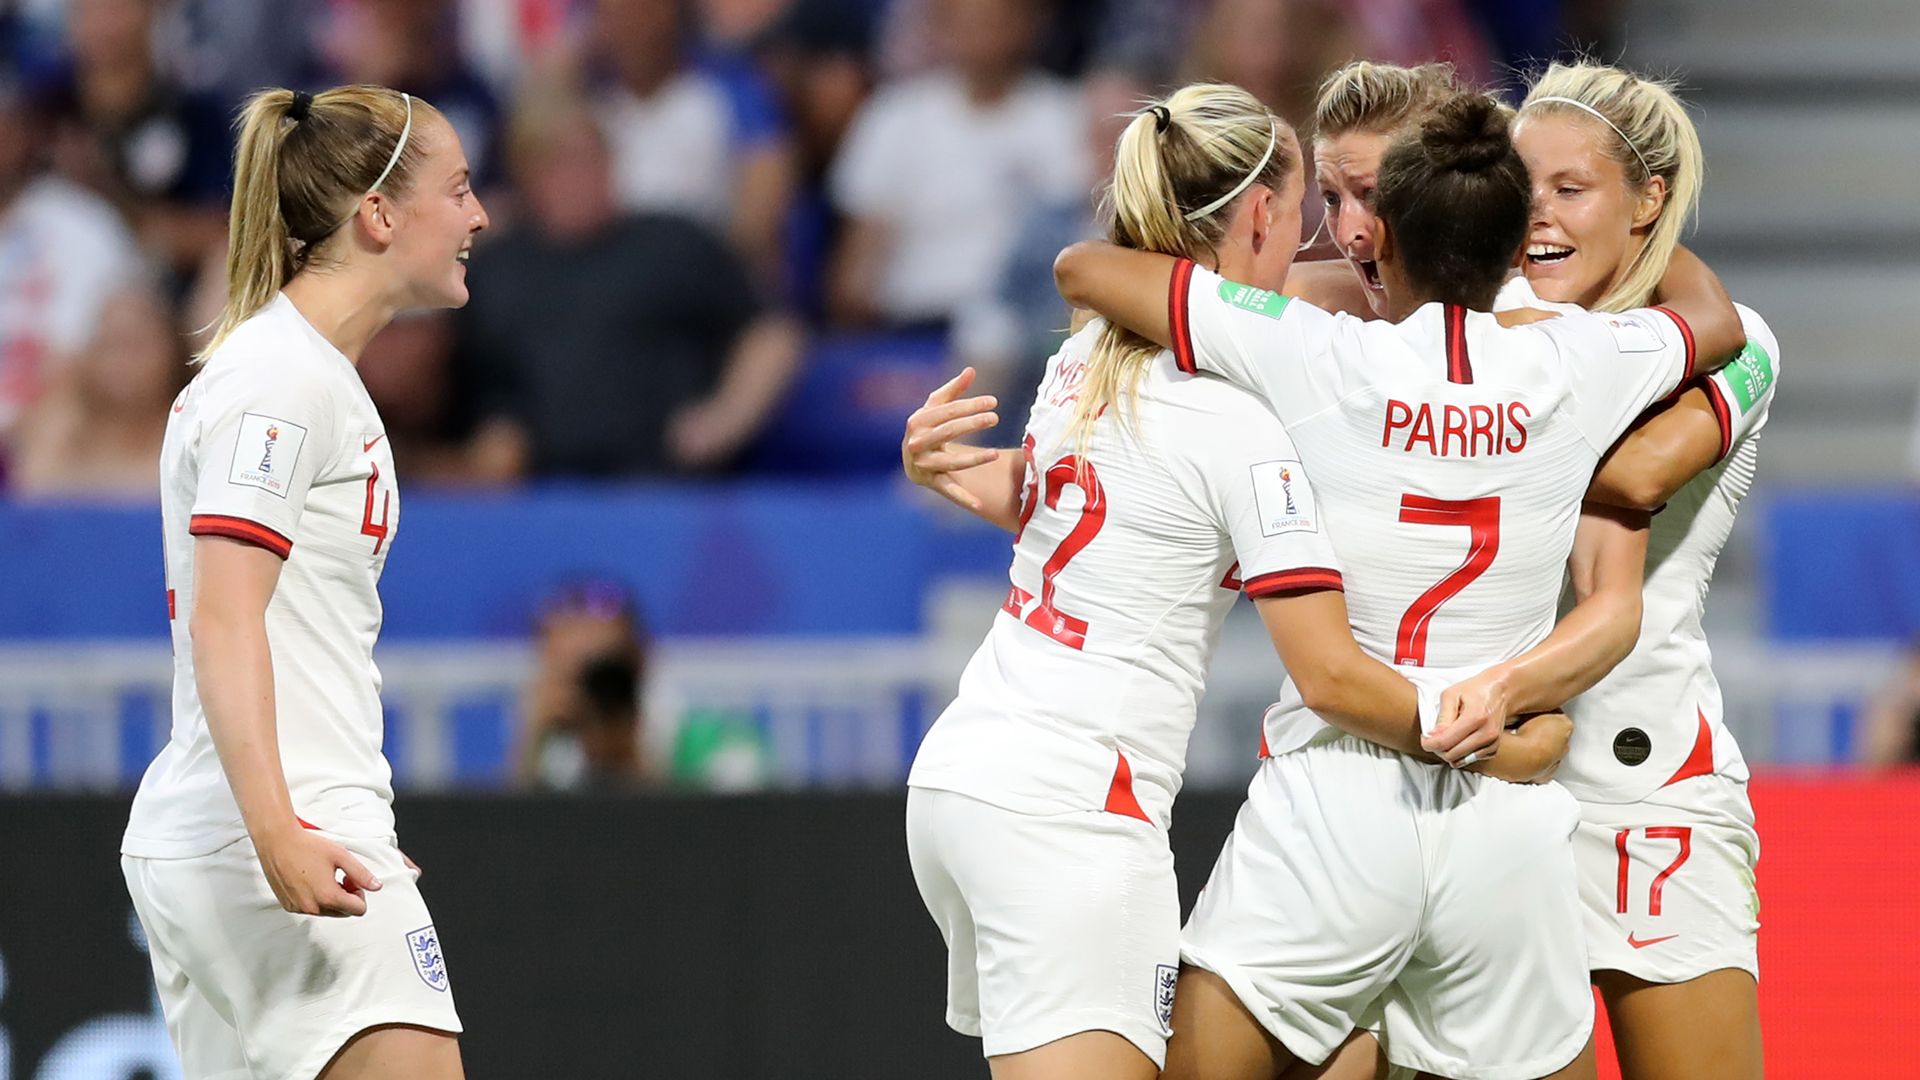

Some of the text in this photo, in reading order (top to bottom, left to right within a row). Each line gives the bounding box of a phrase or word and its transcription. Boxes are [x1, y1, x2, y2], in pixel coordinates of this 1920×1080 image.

[1382, 399, 1531, 457] PARRIS
[361, 461, 390, 555] 4
[1394, 493, 1500, 668] 7
[1615, 826, 1692, 916] 17
